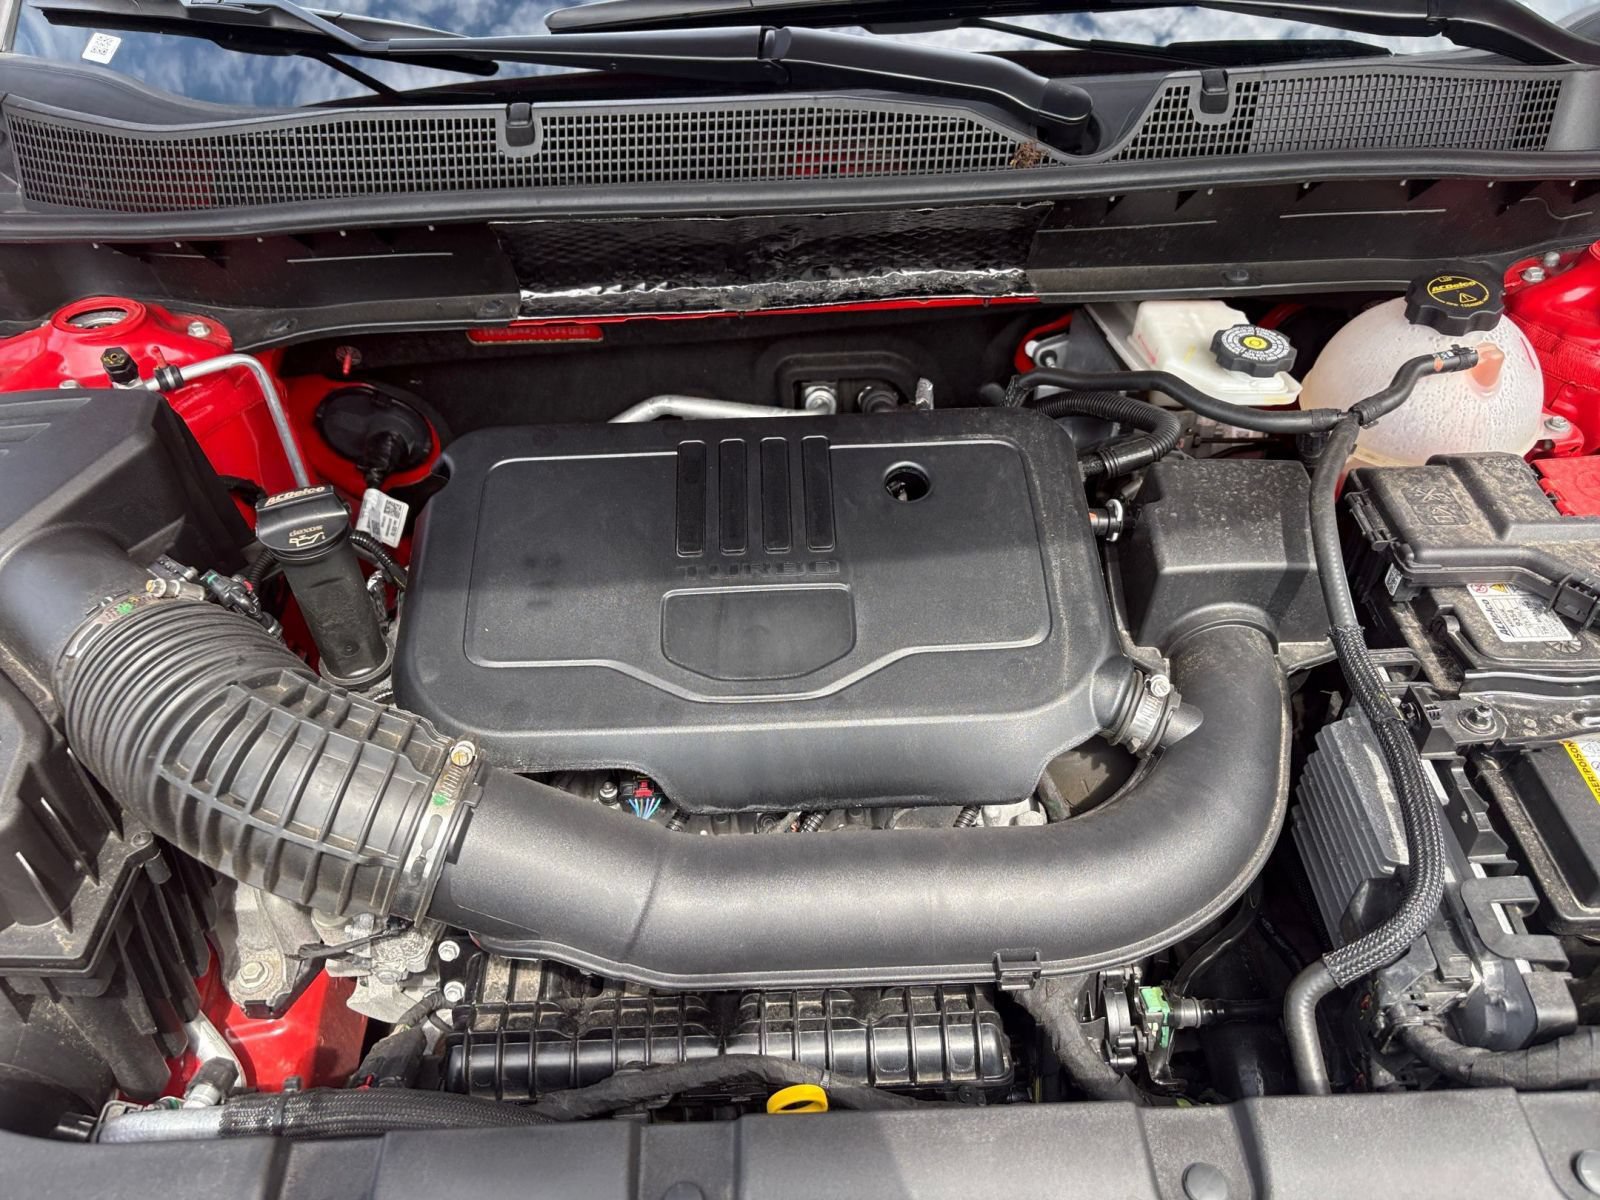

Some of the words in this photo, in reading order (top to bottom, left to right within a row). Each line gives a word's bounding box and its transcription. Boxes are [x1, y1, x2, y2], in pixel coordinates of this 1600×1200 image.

[264, 486, 325, 507] ACDelco
[289, 525, 323, 537] dexos
[676, 559, 840, 582] TURBO
[1481, 598, 1511, 637] ACDelco
